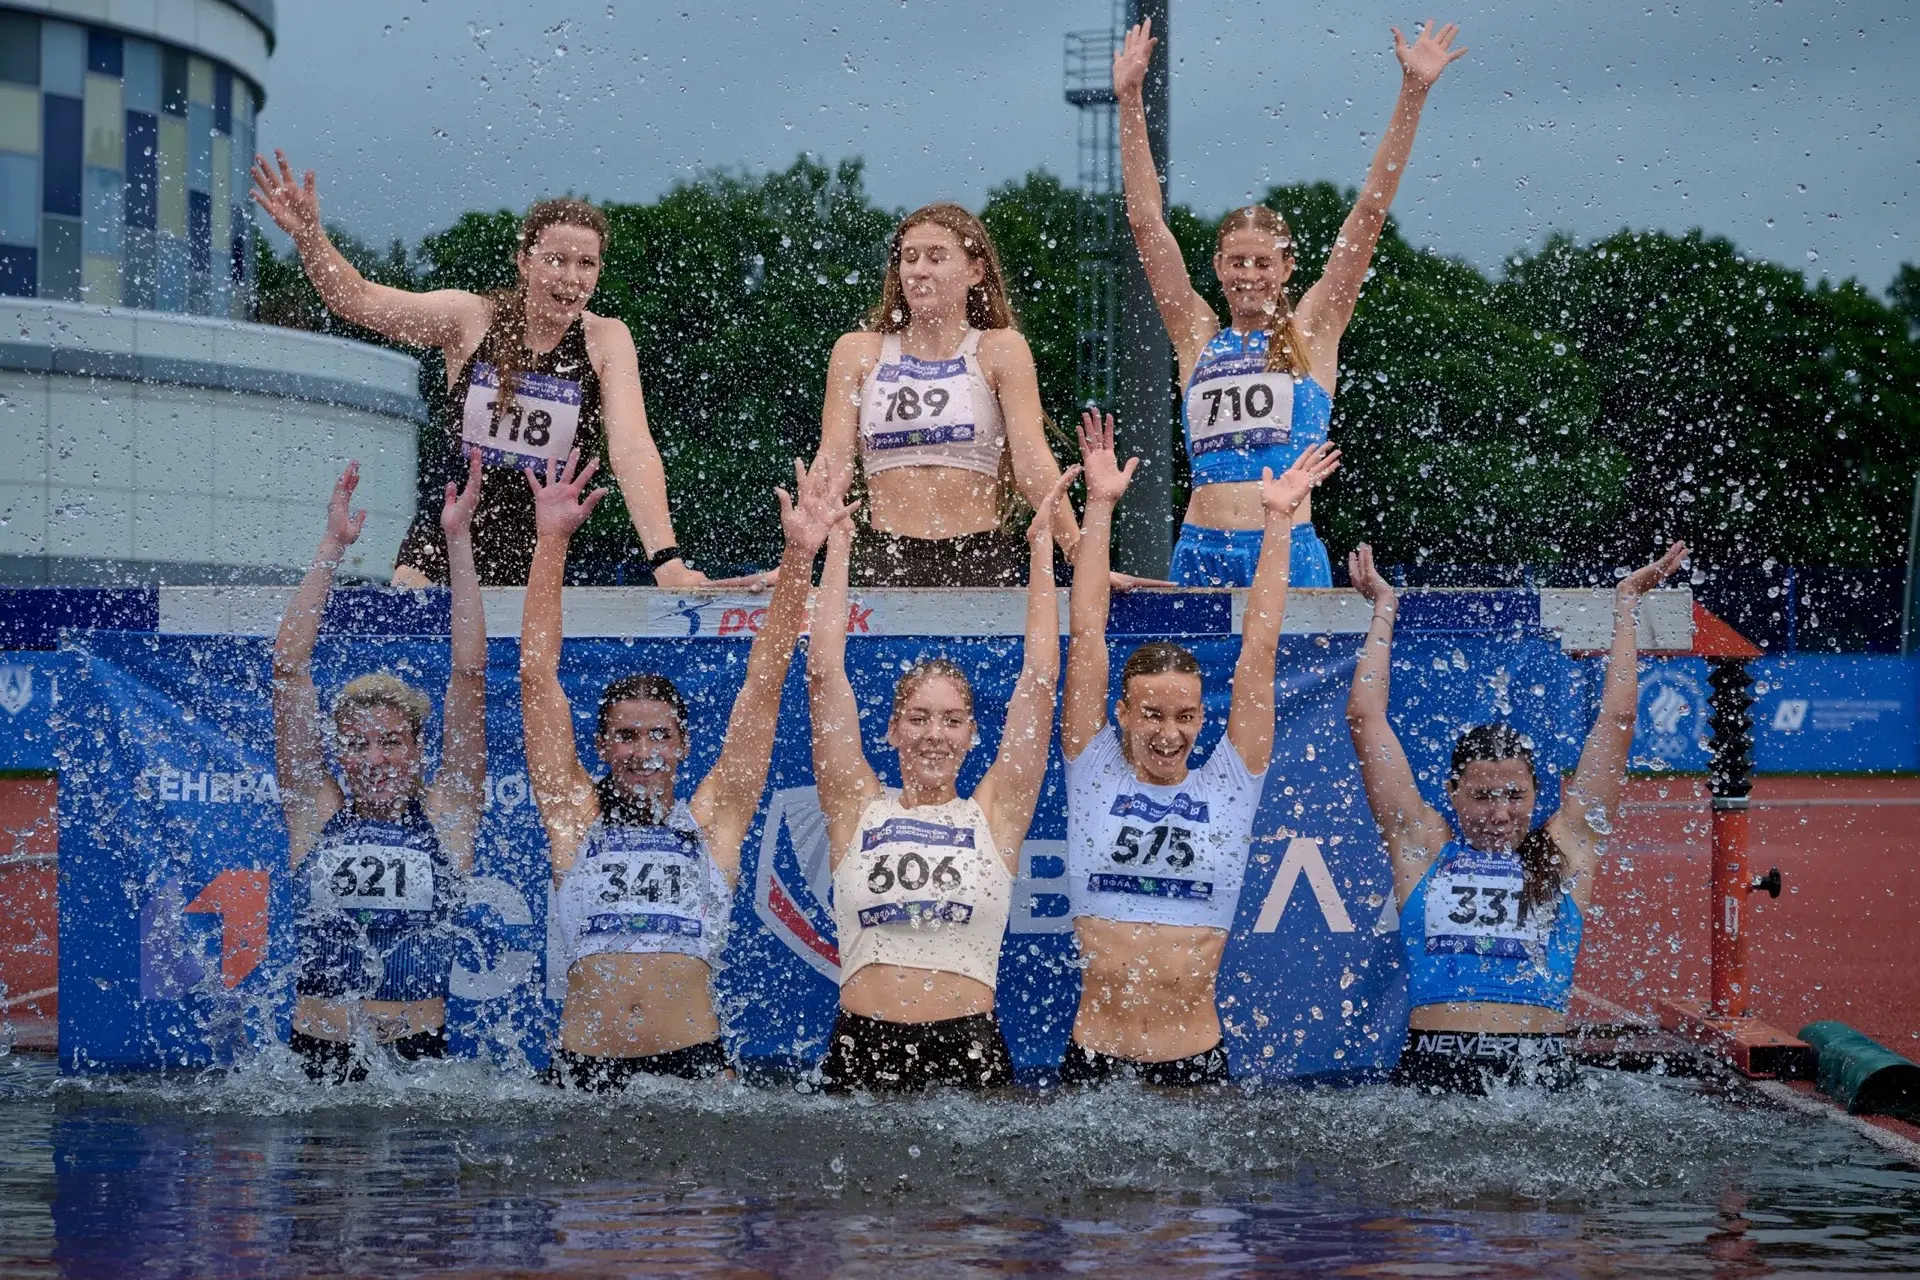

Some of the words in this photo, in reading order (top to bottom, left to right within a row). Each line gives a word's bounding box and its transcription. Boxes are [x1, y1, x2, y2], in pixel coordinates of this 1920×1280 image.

[487, 401, 552, 447] 118
[885, 386, 950, 422] 789
[1202, 383, 1274, 427] 710
[1110, 825, 1195, 868] 575
[330, 855, 406, 898] 621
[600, 863, 681, 904] 341
[867, 851, 962, 894] 606
[1102, 879, 1131, 889] ВФЛА
[1447, 885, 1529, 928] 331
